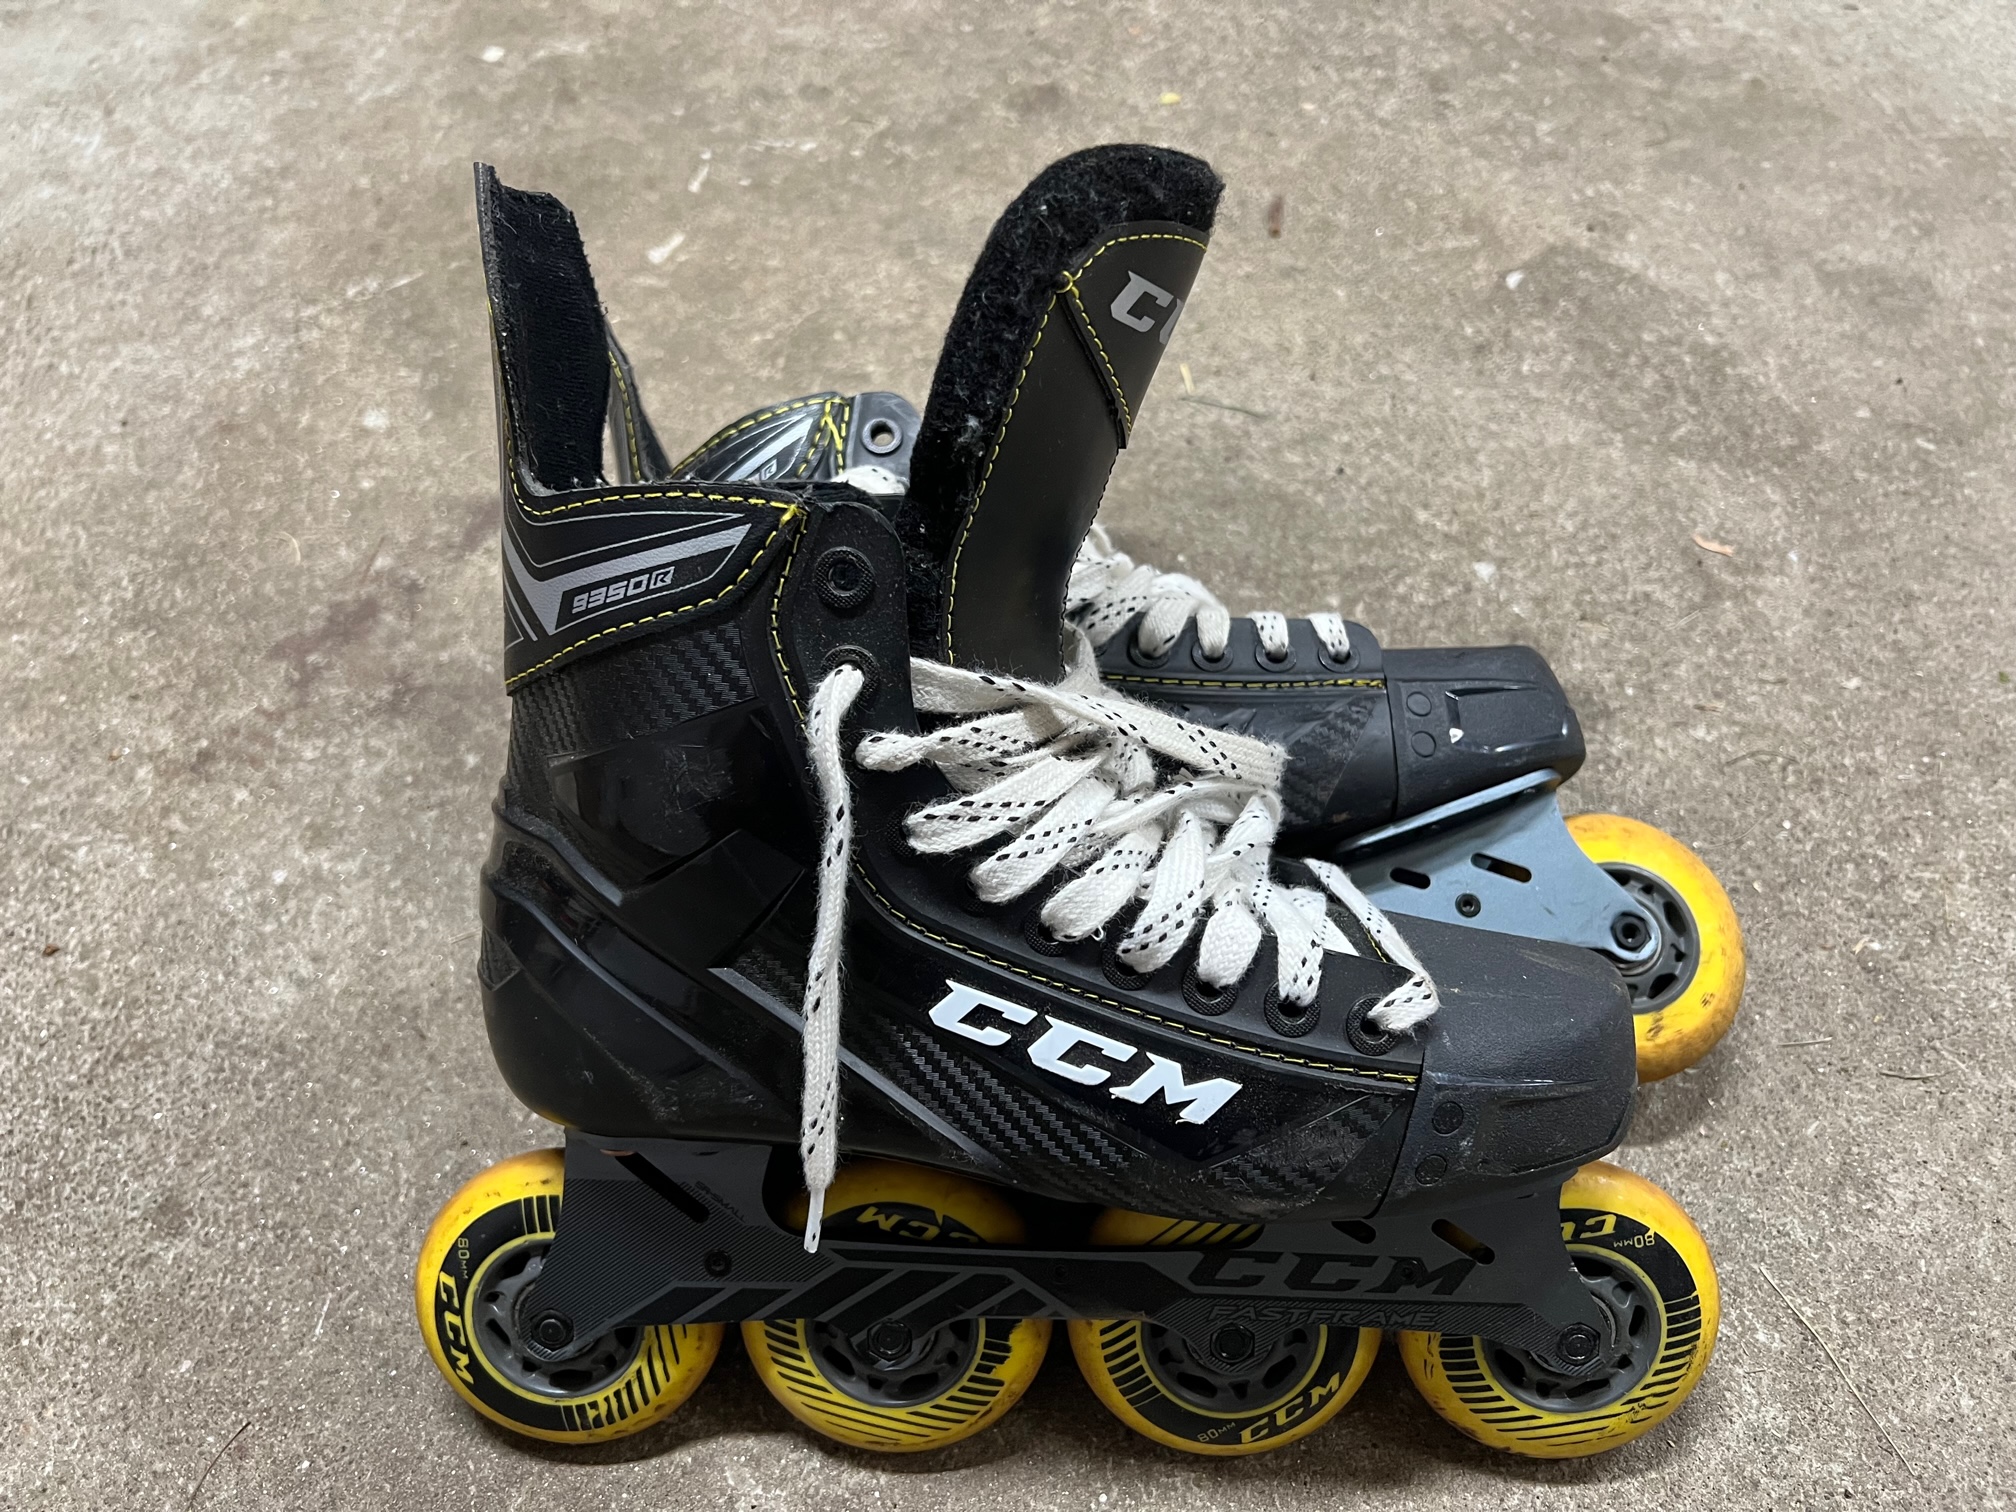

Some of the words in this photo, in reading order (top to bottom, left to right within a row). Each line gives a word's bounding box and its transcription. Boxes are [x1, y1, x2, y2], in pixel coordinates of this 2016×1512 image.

[571, 566, 676, 614] 9350R
[928, 979, 1244, 1125] CCM
[1187, 1251, 1478, 1297] CCM
[438, 1270, 475, 1385] CCM
[1206, 1304, 1438, 1327] FASTFRAME
[1239, 1371, 1341, 1444] CCM
